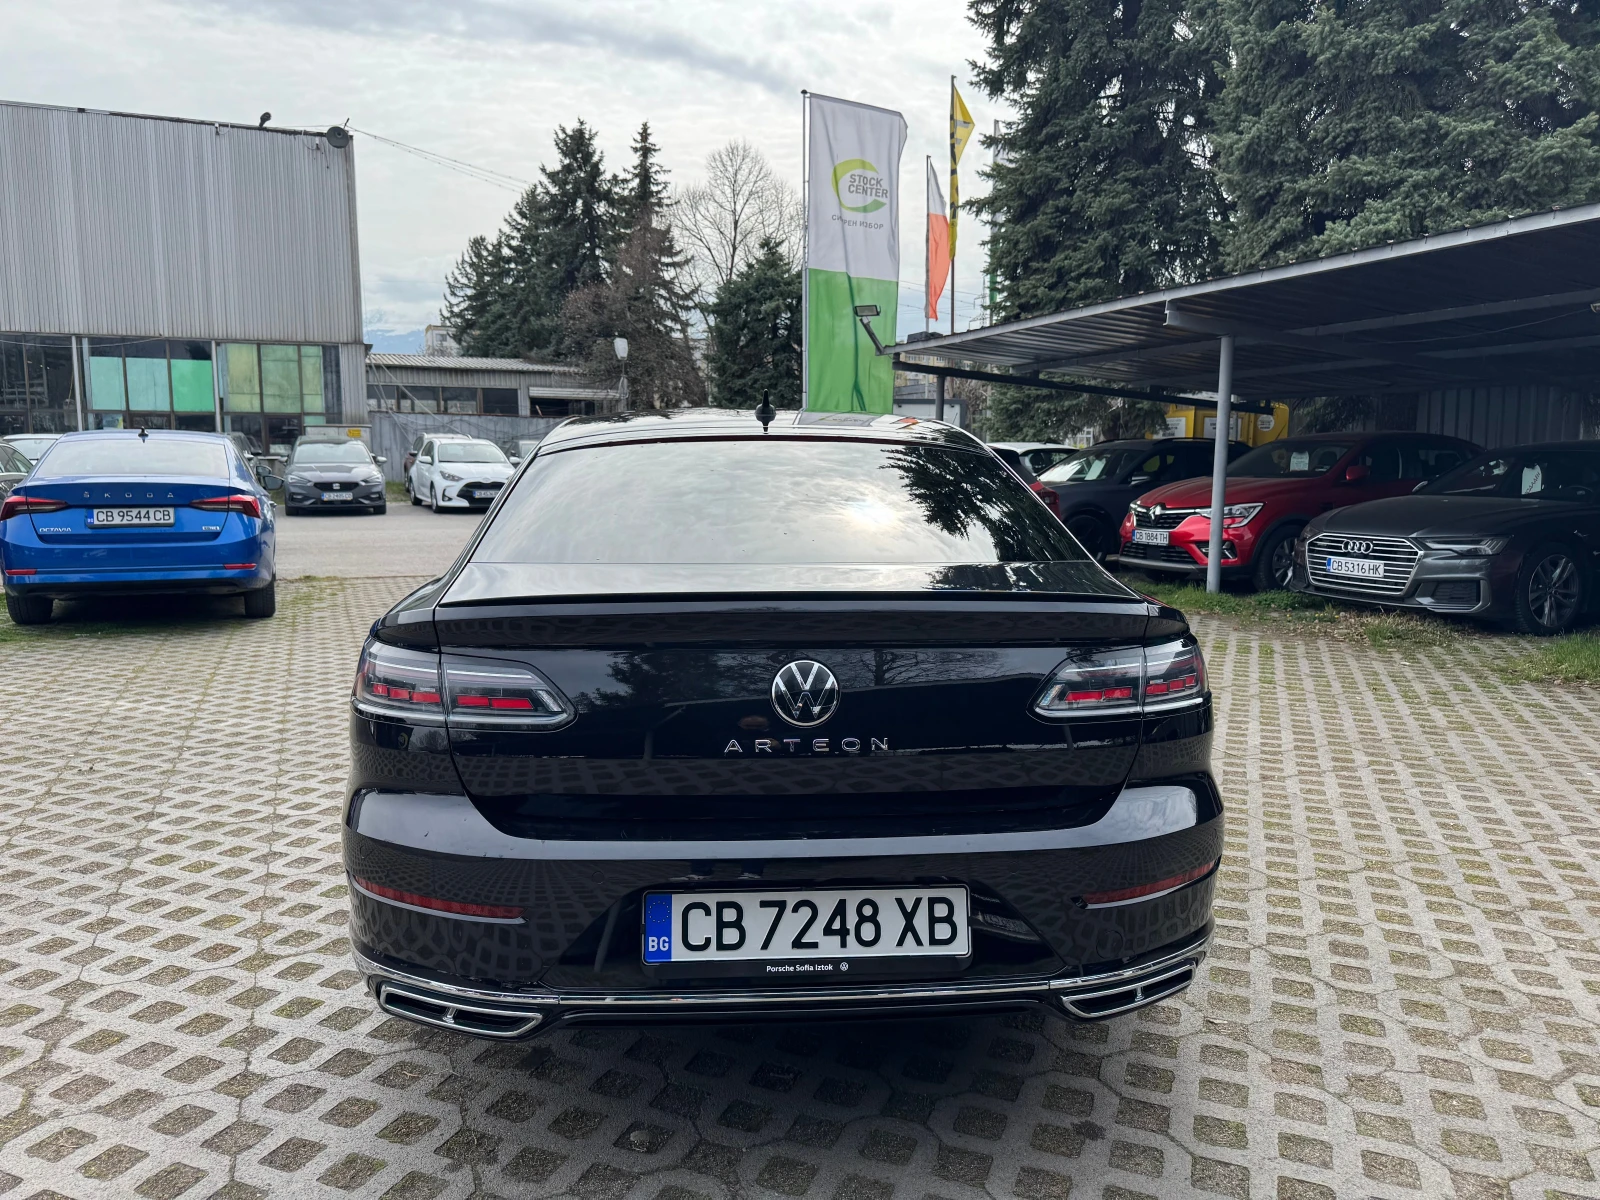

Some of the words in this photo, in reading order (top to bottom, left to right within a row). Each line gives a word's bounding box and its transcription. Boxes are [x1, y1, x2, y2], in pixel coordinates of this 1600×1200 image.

[849, 174, 883, 187] STOCK
[848, 184, 888, 198] CENTER
[96, 510, 115, 523] CB
[117, 510, 151, 522] 9544
[153, 509, 171, 522] CB
[1332, 560, 1343, 571] CB
[1344, 562, 1366, 574] 5316
[1368, 563, 1381, 576] HK
[723, 737, 890, 754] ARTEON
[681, 900, 747, 952] CB
[759, 897, 881, 950] 7248
[894, 895, 958, 947] XB
[648, 936, 670, 952] BG
[766, 965, 795, 973] Porsche
[795, 964, 814, 972] Sofia
[815, 963, 834, 972] Iztok
